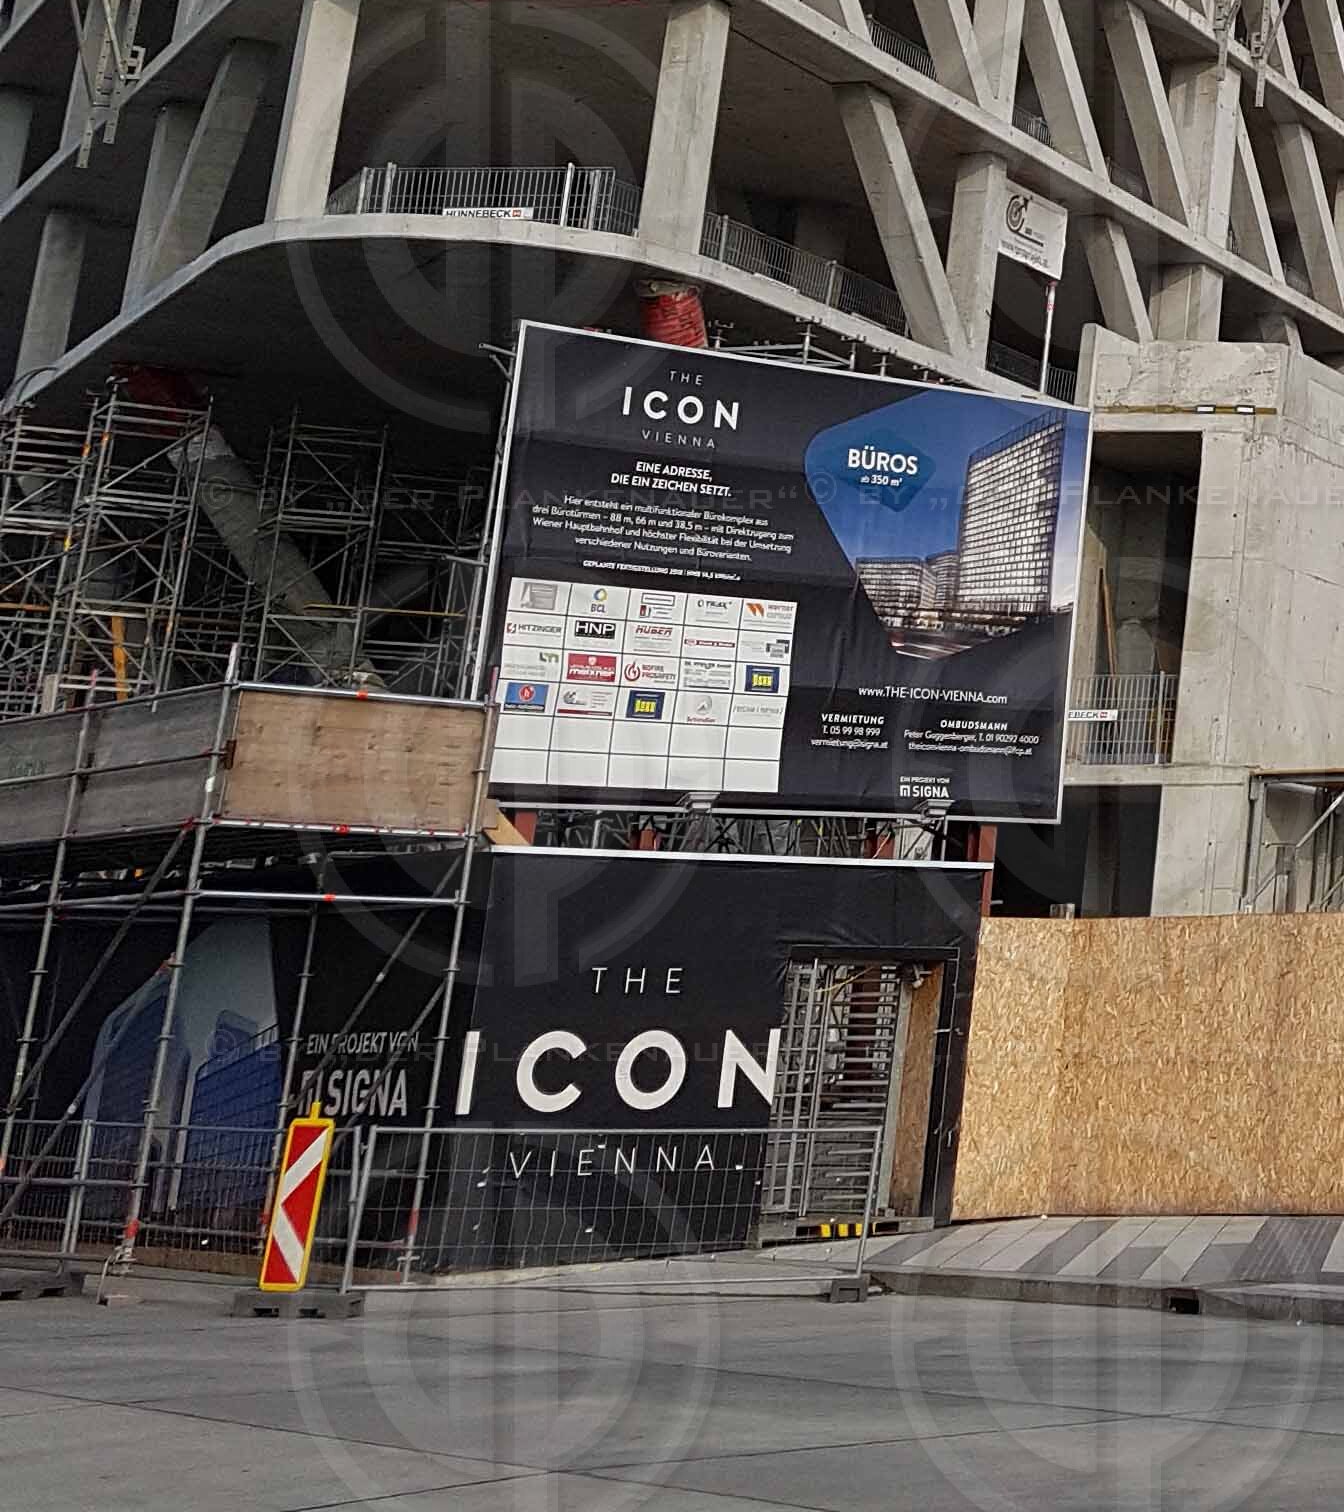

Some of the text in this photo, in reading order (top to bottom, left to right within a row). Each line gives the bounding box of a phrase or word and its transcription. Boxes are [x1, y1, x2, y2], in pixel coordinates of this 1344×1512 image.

[669, 371, 703, 384] THE
[622, 386, 739, 430] ICON
[642, 429, 715, 449] VIENNA
[848, 445, 917, 474] BÜROS
[636, 461, 713, 482] EINE ADRESSE,
[871, 475, 888, 485] 350
[611, 473, 732, 497] DIE EIN ZEICHEN SETZT.
[533, 517, 563, 528] Wiener
[565, 520, 624, 534] Hauptbahnhof
[625, 527, 640, 536] und
[658, 519, 673, 528] und
[679, 547, 694, 555] und
[575, 622, 614, 635] HNP
[858, 686, 1008, 704] www.THE-ICON-VIENNA.com
[821, 713, 884, 725] VERMIETUNG
[940, 720, 1008, 731] OMBUDSMANN
[830, 726, 841, 735] 05
[842, 727, 852, 736] 99
[854, 727, 864, 736] 98
[904, 730, 923, 739] Peter
[913, 786, 949, 798] SIGNA
[592, 967, 682, 993] THE
[307, 1034, 329, 1054] EIN
[455, 1028, 781, 1115] ICON
[325, 1069, 407, 1116] SIGNA
[510, 1145, 714, 1179] VIENNA
